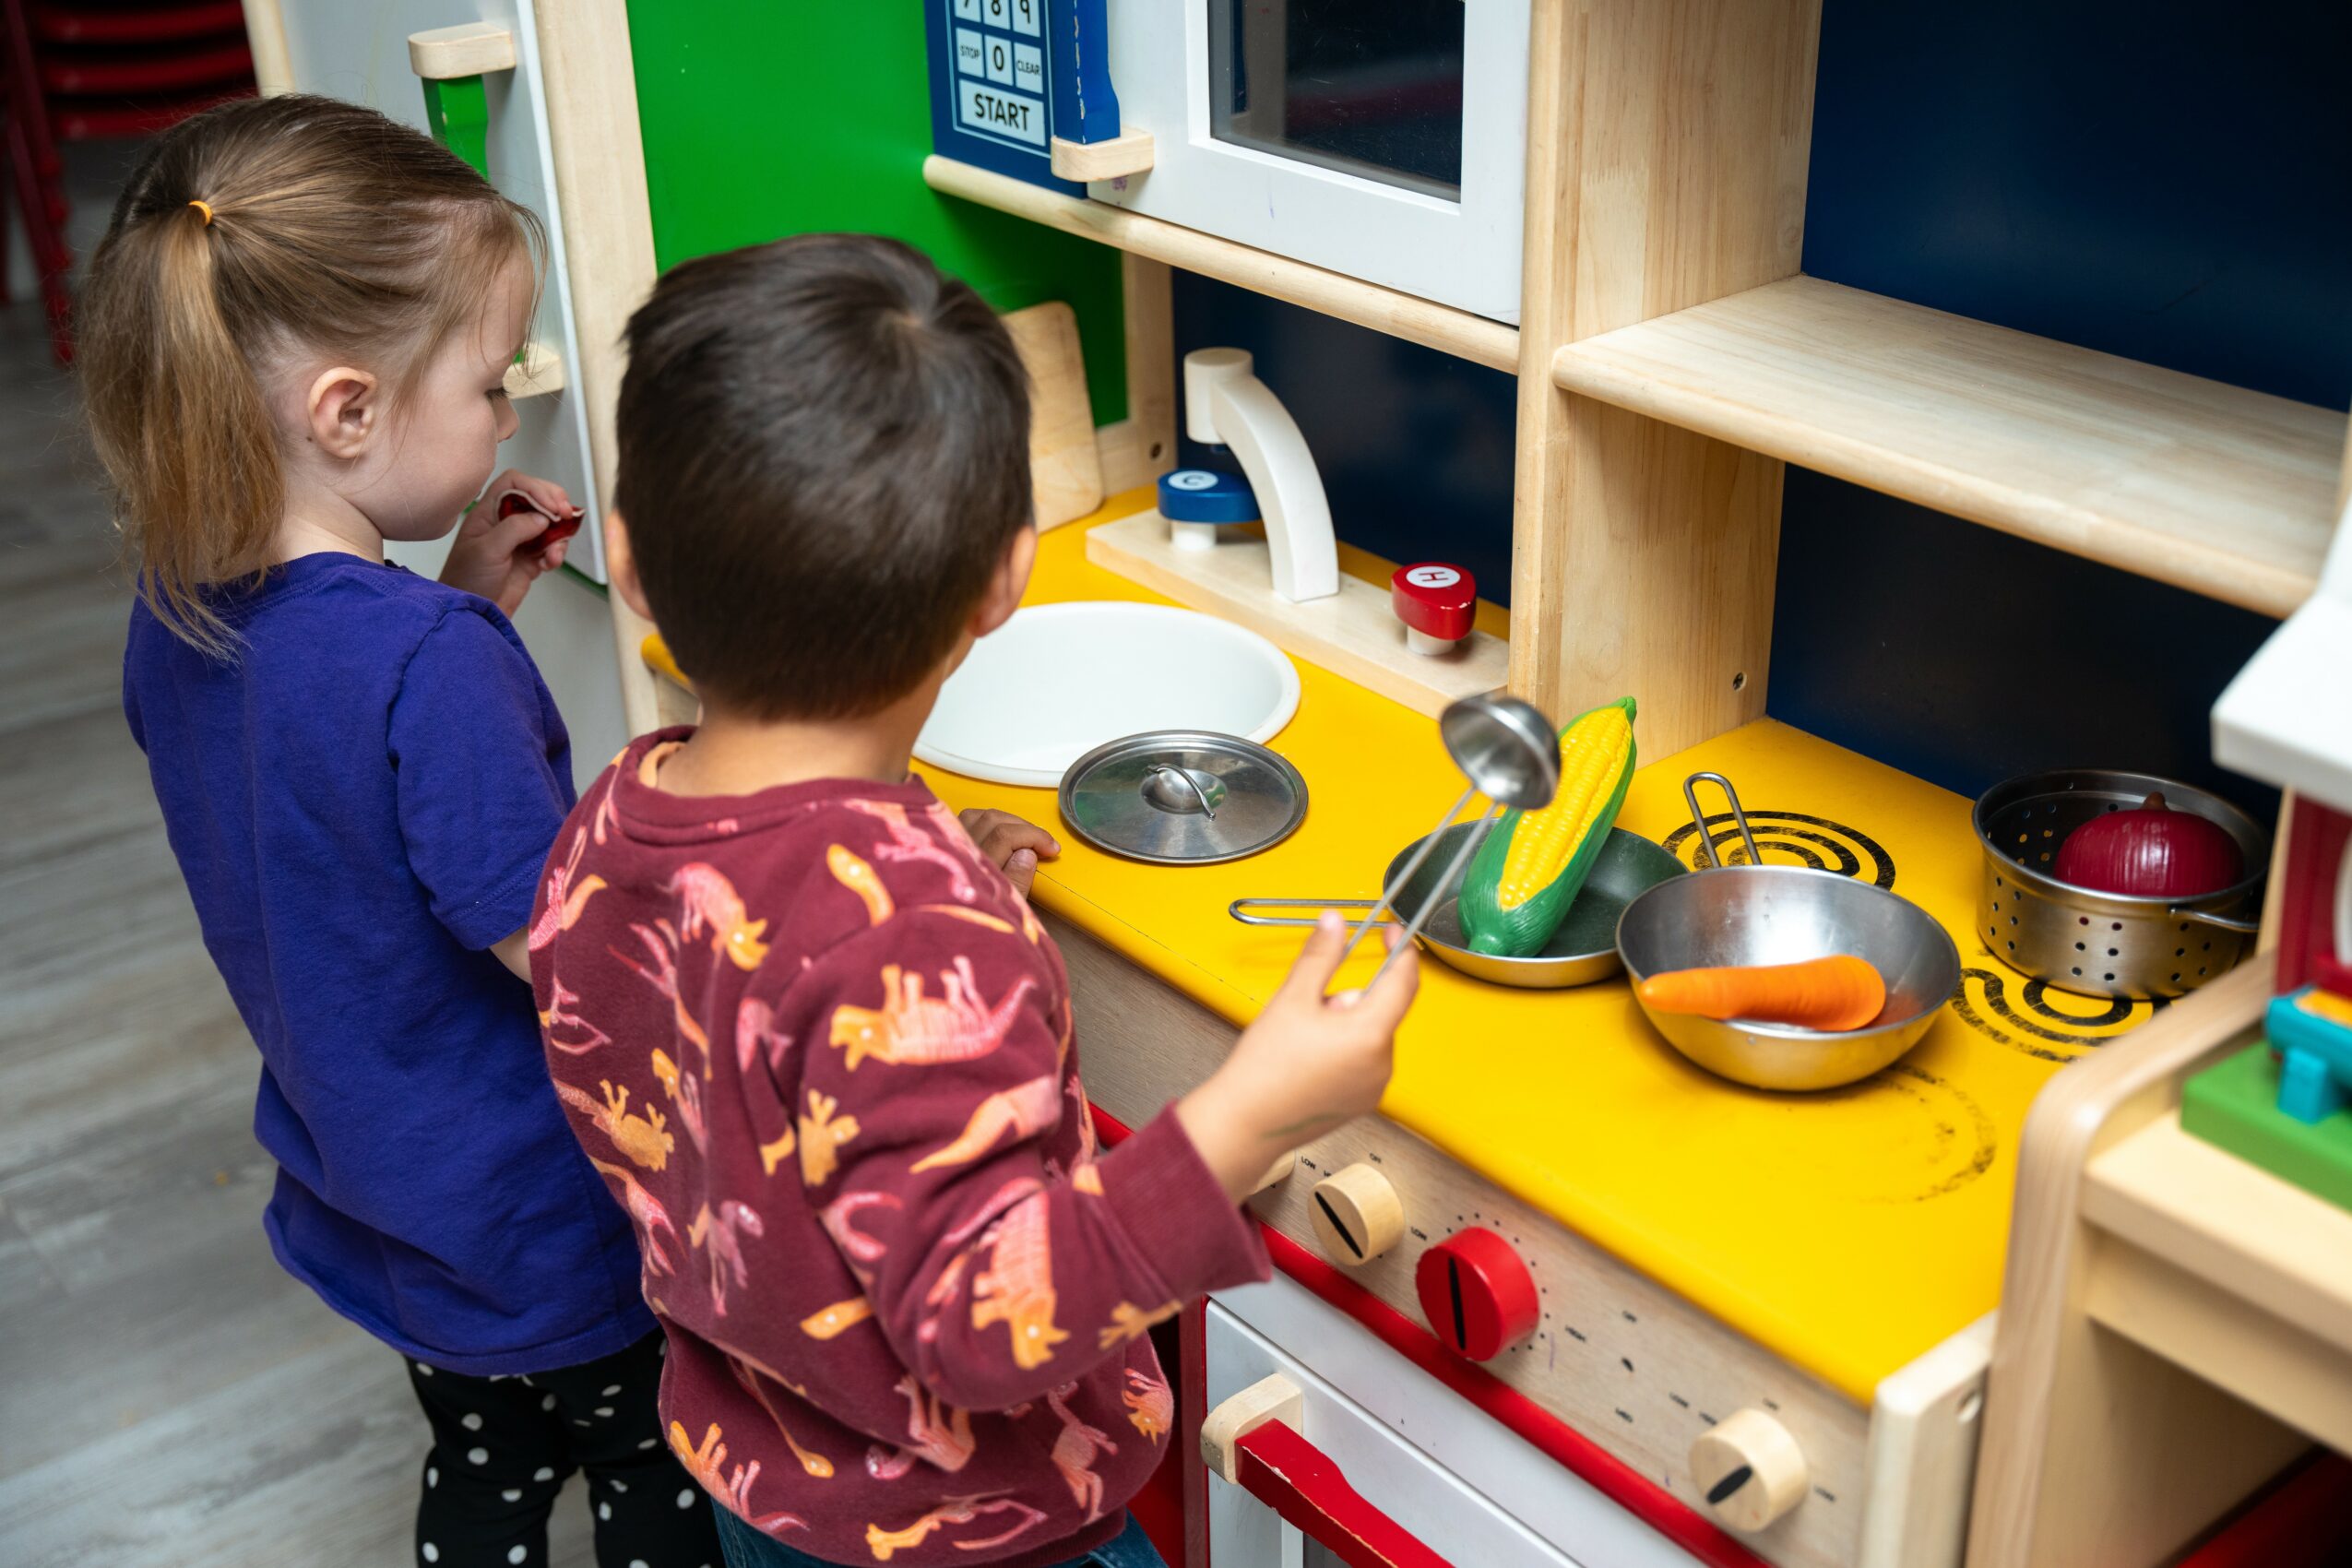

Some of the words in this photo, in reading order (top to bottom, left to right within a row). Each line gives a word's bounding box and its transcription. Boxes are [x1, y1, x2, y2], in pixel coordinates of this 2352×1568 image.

[1020, 0, 1031, 24] 9
[960, 45, 980, 58] STOP
[993, 45, 1004, 71] 0
[1016, 60, 1040, 75] CLEAR
[974, 93, 1029, 131] START
[1182, 475, 1204, 486] C
[1419, 572, 1449, 581] H
[1301, 1156, 1316, 1170] LOW
